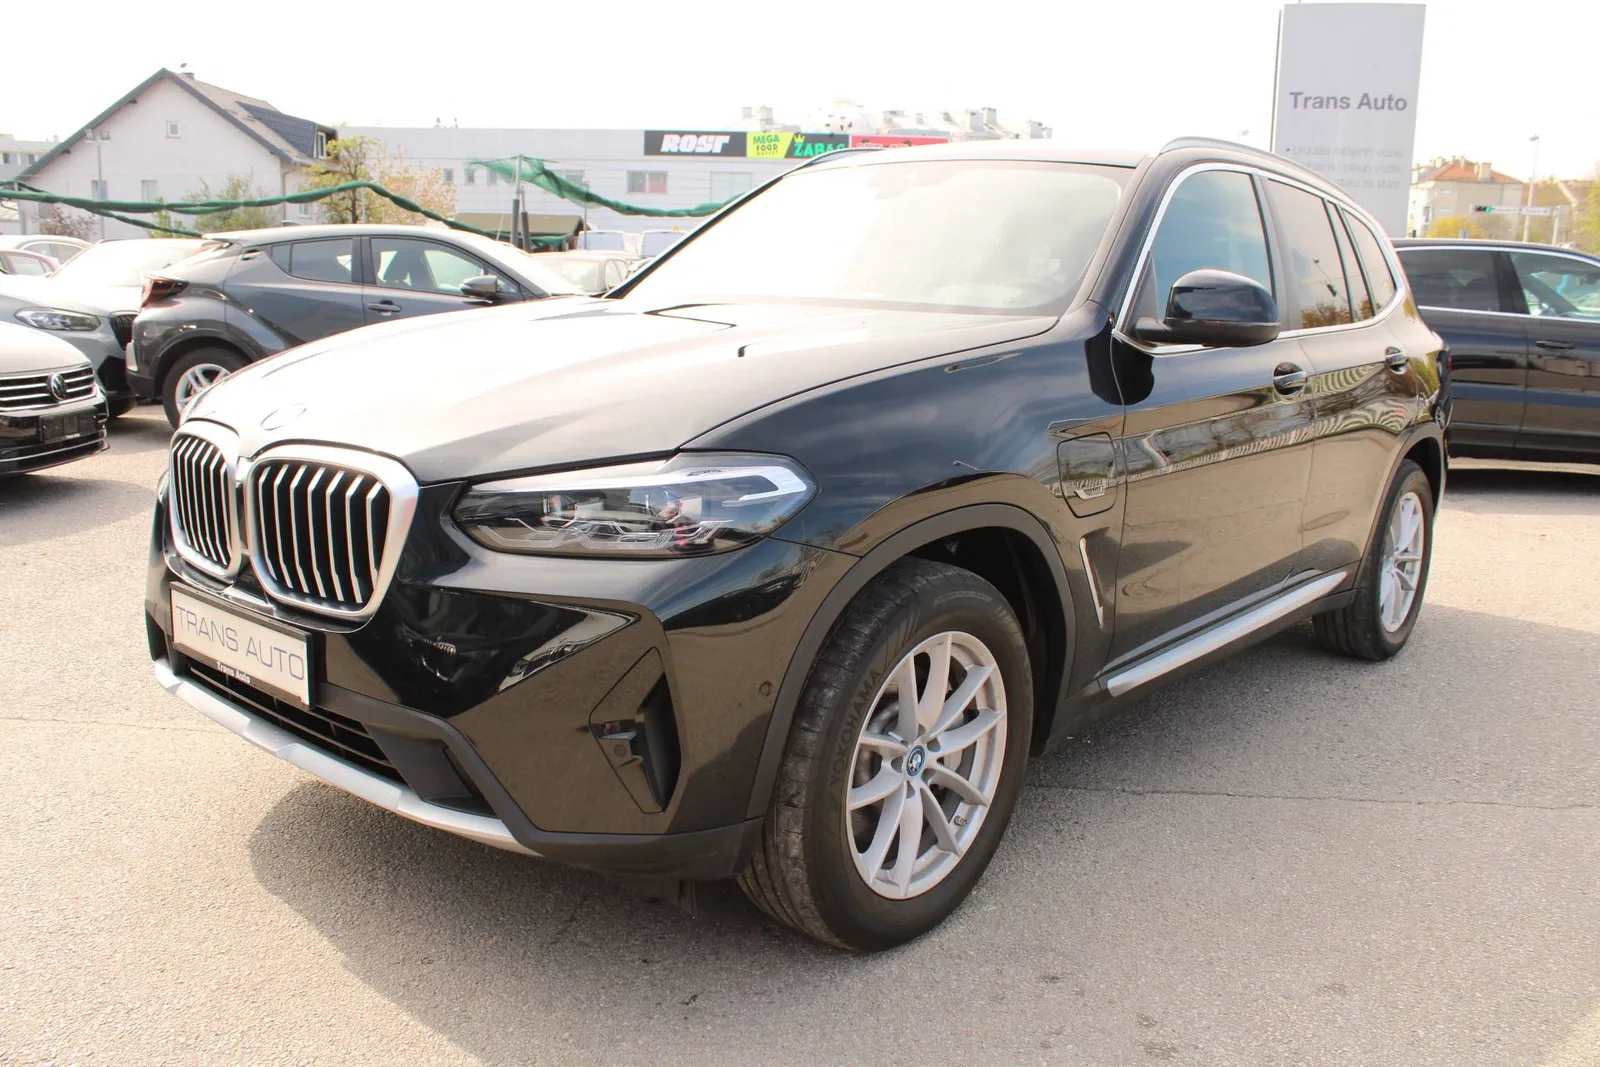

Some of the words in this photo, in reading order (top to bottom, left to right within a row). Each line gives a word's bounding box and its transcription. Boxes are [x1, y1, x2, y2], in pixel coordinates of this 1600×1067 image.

[1289, 92, 1351, 110] Trans
[1356, 93, 1407, 111] Auto
[753, 134, 780, 144] MEGA
[176, 605, 239, 652] TRANS
[246, 636, 305, 681] AUTO
[217, 660, 235, 677] Trans
[829, 669, 881, 787] YOKOHAMA
